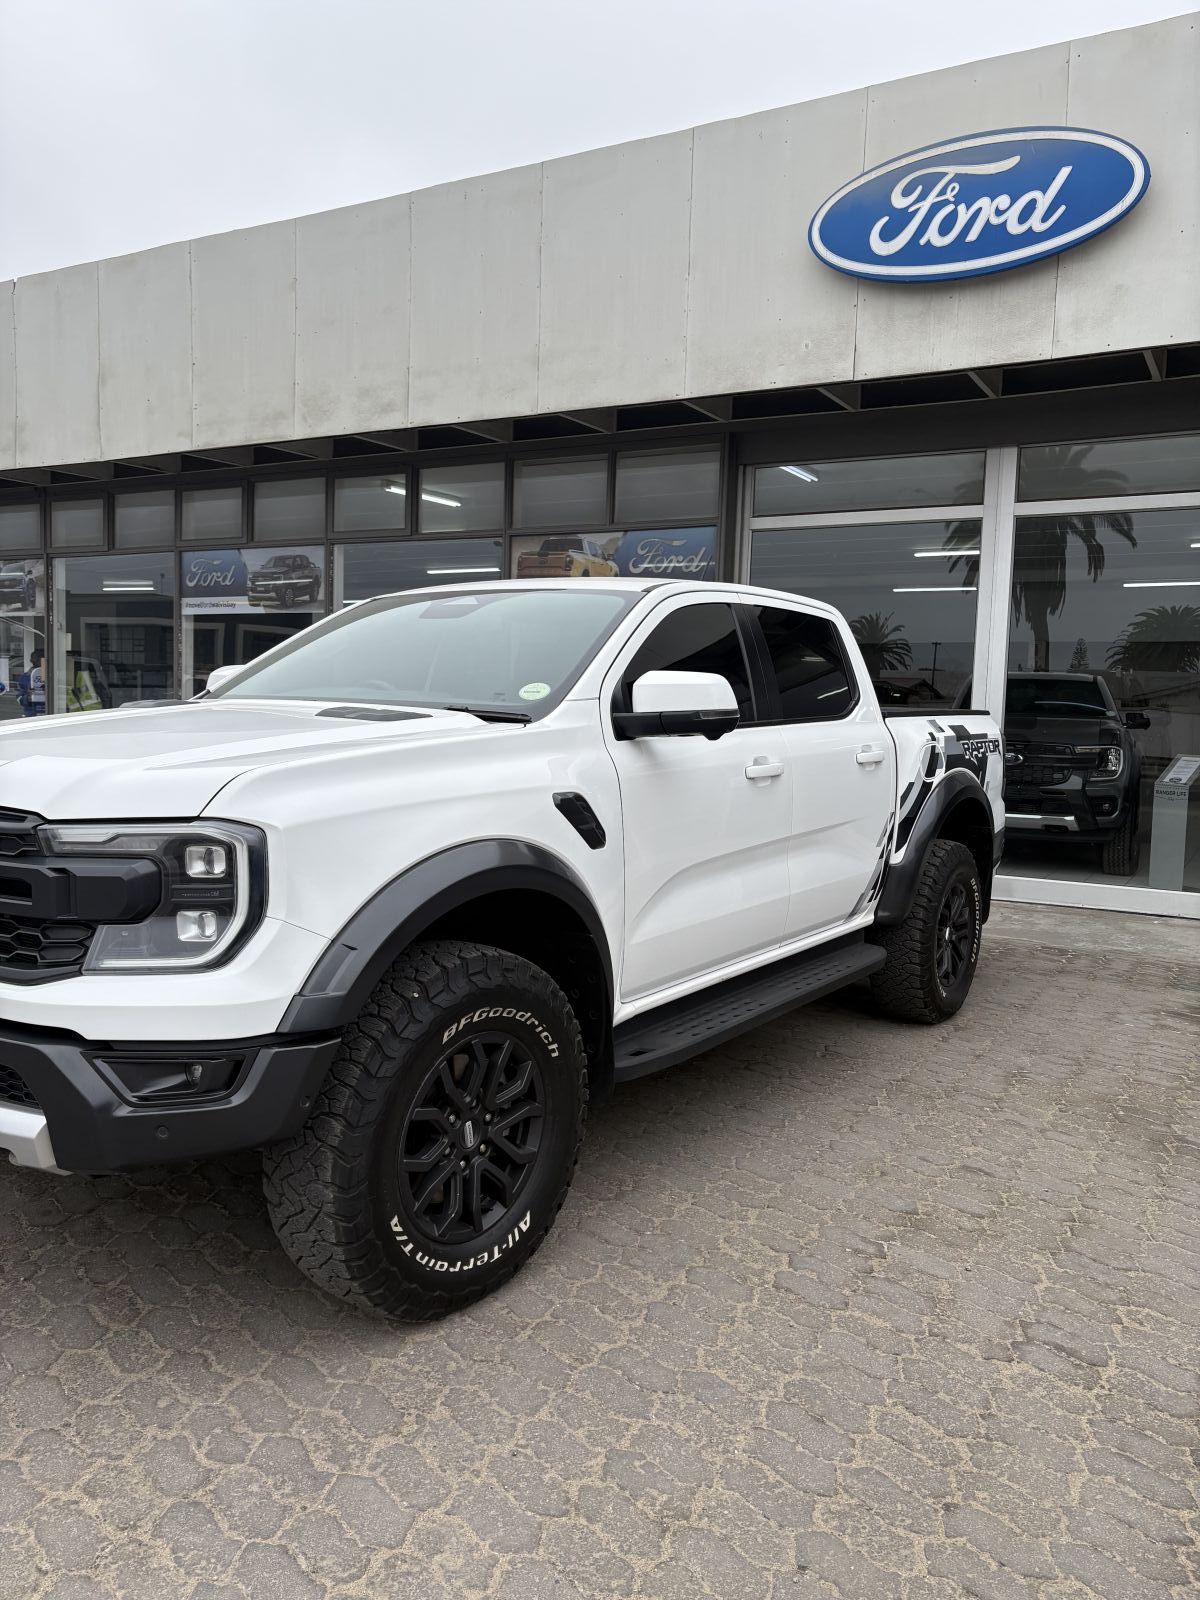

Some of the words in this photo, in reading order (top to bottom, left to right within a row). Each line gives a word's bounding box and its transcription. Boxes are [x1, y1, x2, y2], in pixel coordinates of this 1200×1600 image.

[869, 155, 1073, 257] Ford
[186, 558, 236, 588] Ford
[629, 538, 706, 574] Ford
[960, 738, 1001, 763] RAPTOR
[442, 1006, 559, 1058] BFGoodrich
